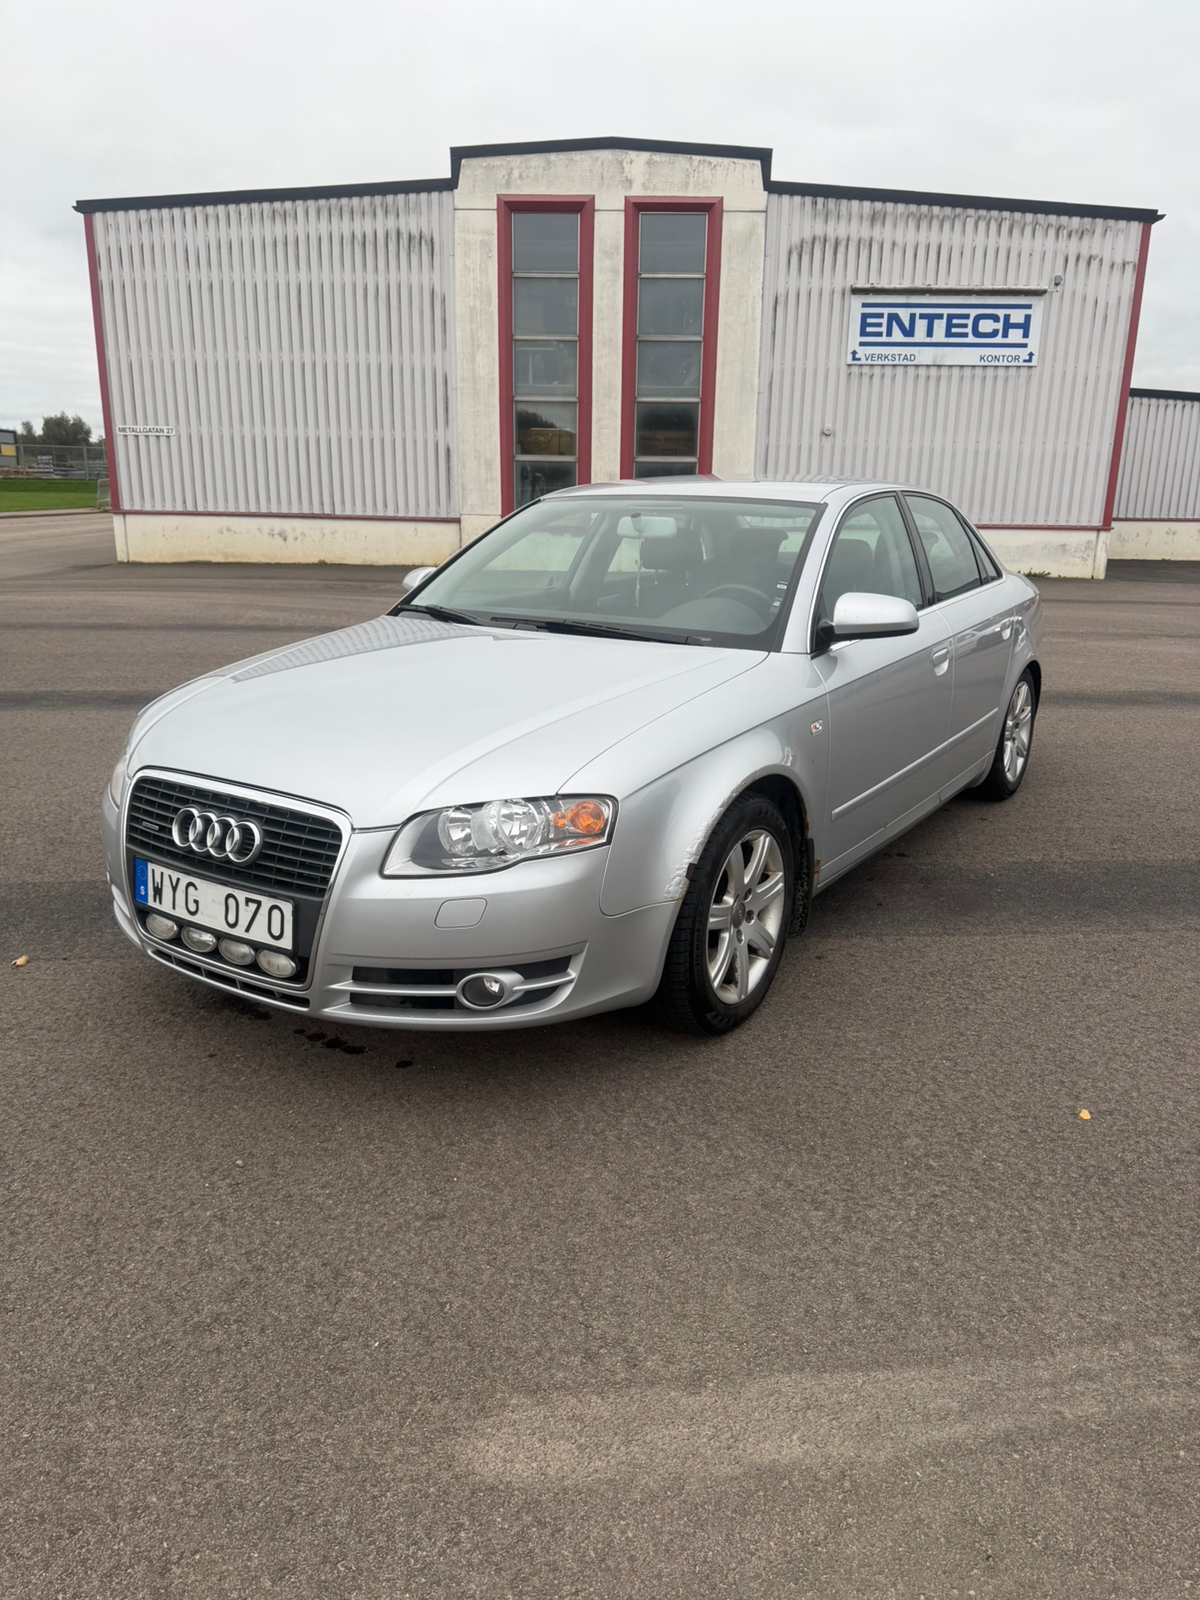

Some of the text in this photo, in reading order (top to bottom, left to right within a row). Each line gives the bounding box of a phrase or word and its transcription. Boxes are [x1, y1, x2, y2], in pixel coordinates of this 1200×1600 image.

[859, 312, 1032, 339] ENTECH
[864, 353, 916, 363] VERKSTAD
[979, 354, 1021, 363] KONTOR
[118, 426, 165, 434] METALLGATAN
[139, 885, 146, 896] S
[151, 868, 285, 941] WYG 070
